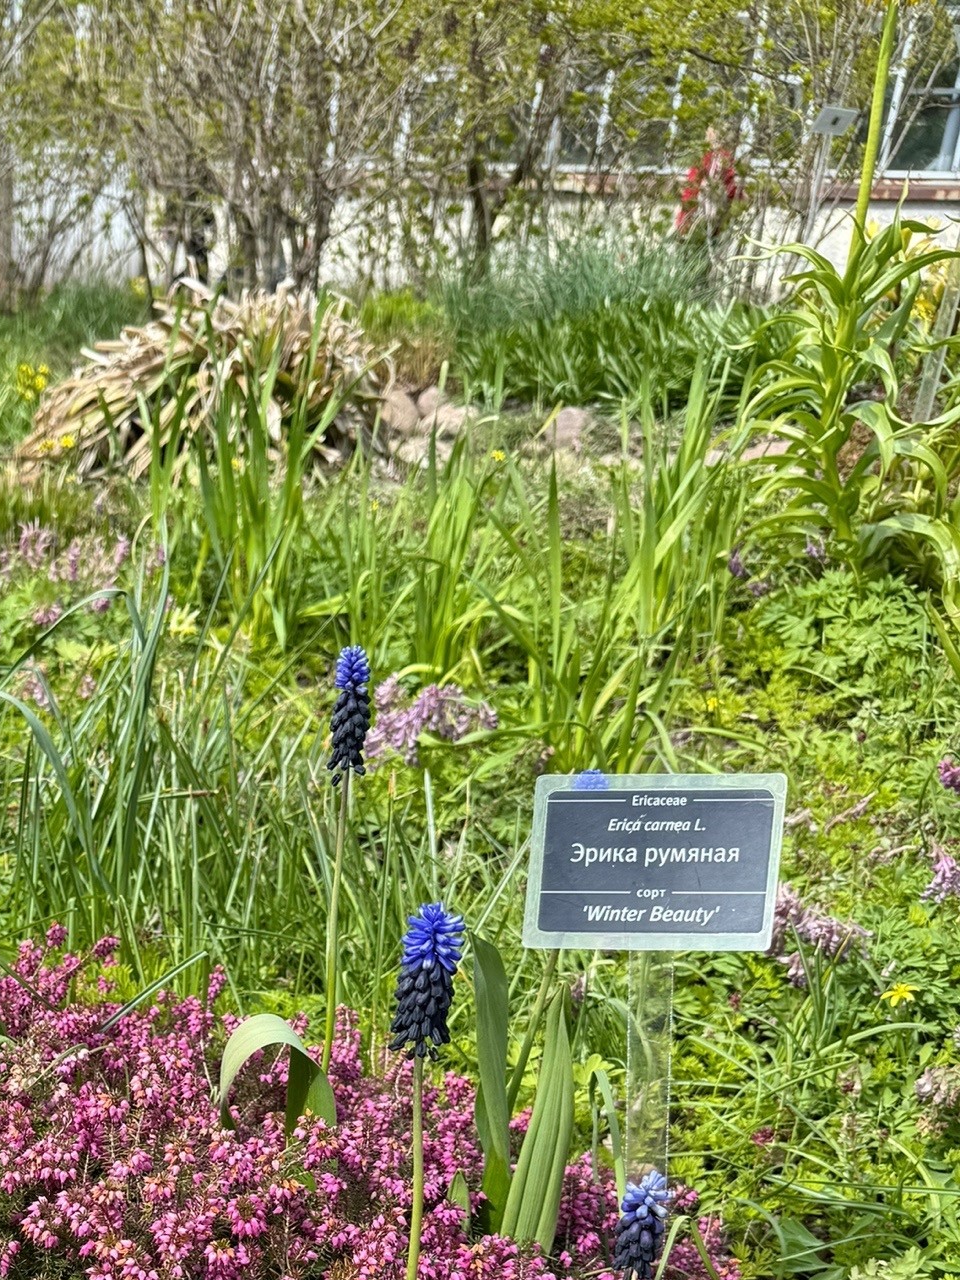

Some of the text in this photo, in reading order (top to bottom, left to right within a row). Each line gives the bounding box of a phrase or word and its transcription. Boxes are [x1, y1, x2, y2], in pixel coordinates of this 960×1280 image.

[631, 794, 688, 807] Ericaceae
[607, 817, 707, 832] Erica carnea L.
[570, 843, 741, 867] Эрика румяная
[636, 887, 667, 899] сорт
[582, 906, 721, 926] 'Winter Beauty'
